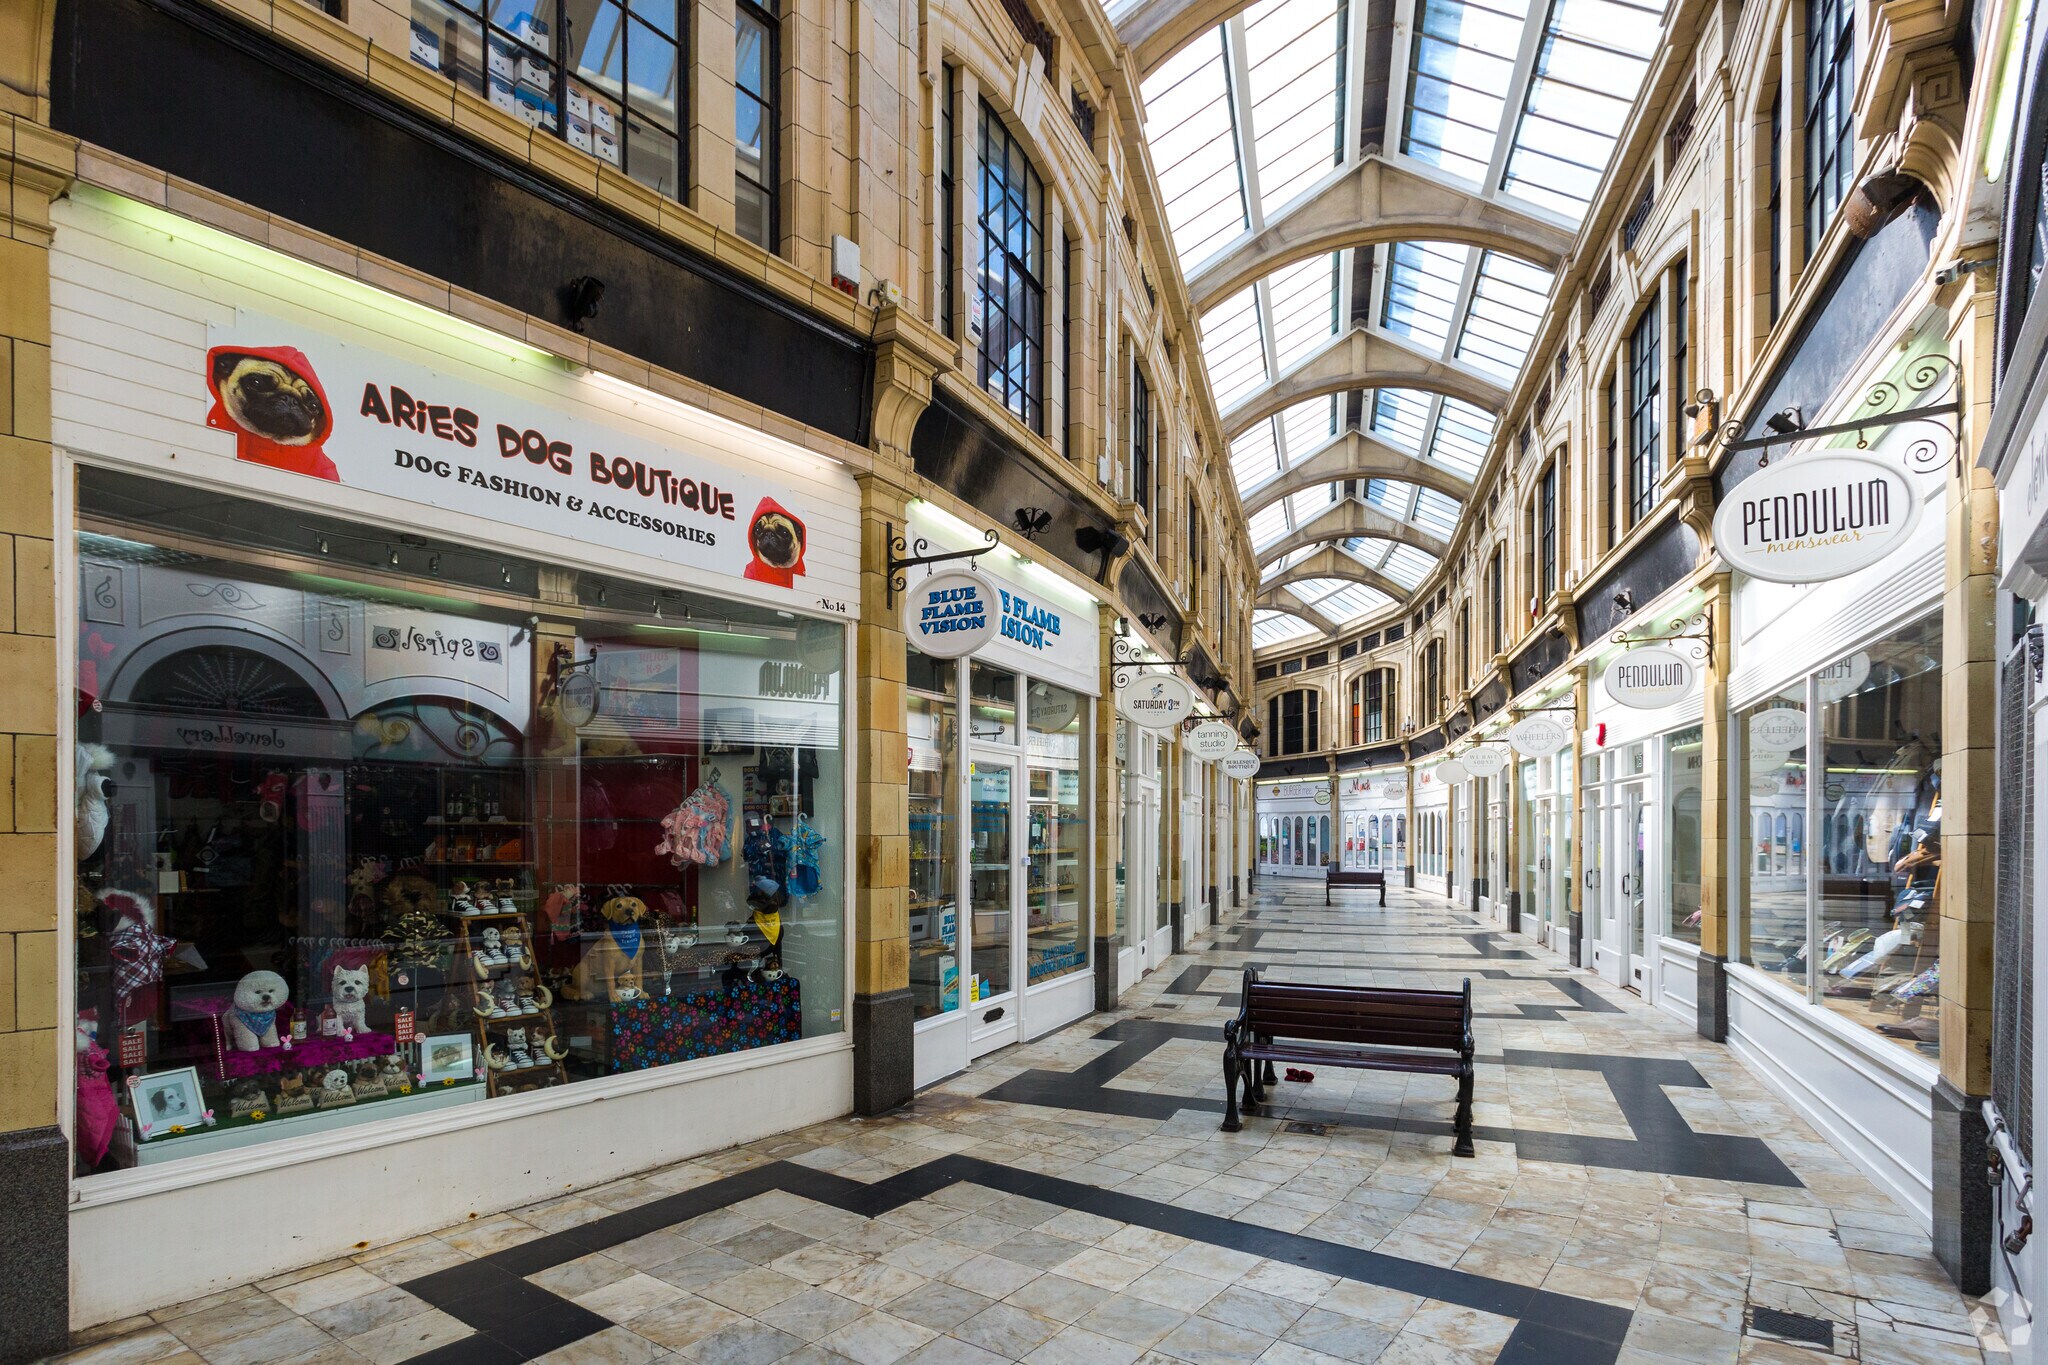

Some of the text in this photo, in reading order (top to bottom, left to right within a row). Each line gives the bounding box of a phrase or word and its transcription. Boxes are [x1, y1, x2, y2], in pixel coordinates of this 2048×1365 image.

[496, 423, 573, 475] DOG
[394, 449, 716, 547] DOG FASHION & ACCESSORIES
[1742, 478, 1889, 546] PENDULUM
[1766, 530, 1865, 554] menswear
[928, 586, 976, 605] BLUE
[836, 601, 846, 613] 14
[921, 600, 984, 621] FLAME
[1013, 596, 1061, 636] FLAME
[919, 615, 987, 635] VISION
[1000, 614, 1043, 650] ISION
[1618, 663, 1683, 688] PENDULUM
[1133, 700, 1167, 710] SATURDAY
[1197, 730, 1228, 739] tanning
[1516, 733, 1561, 741] WHEELERS
[1199, 740, 1226, 748] studio
[397, 1016, 412, 1024] SALE
[397, 1022, 413, 1030] SALE
[122, 1038, 142, 1046] SALE
[398, 1033, 414, 1041] SALE
[122, 1044, 143, 1053] SALE
[123, 1051, 143, 1059] SALE
[123, 1057, 143, 1066] SALE
